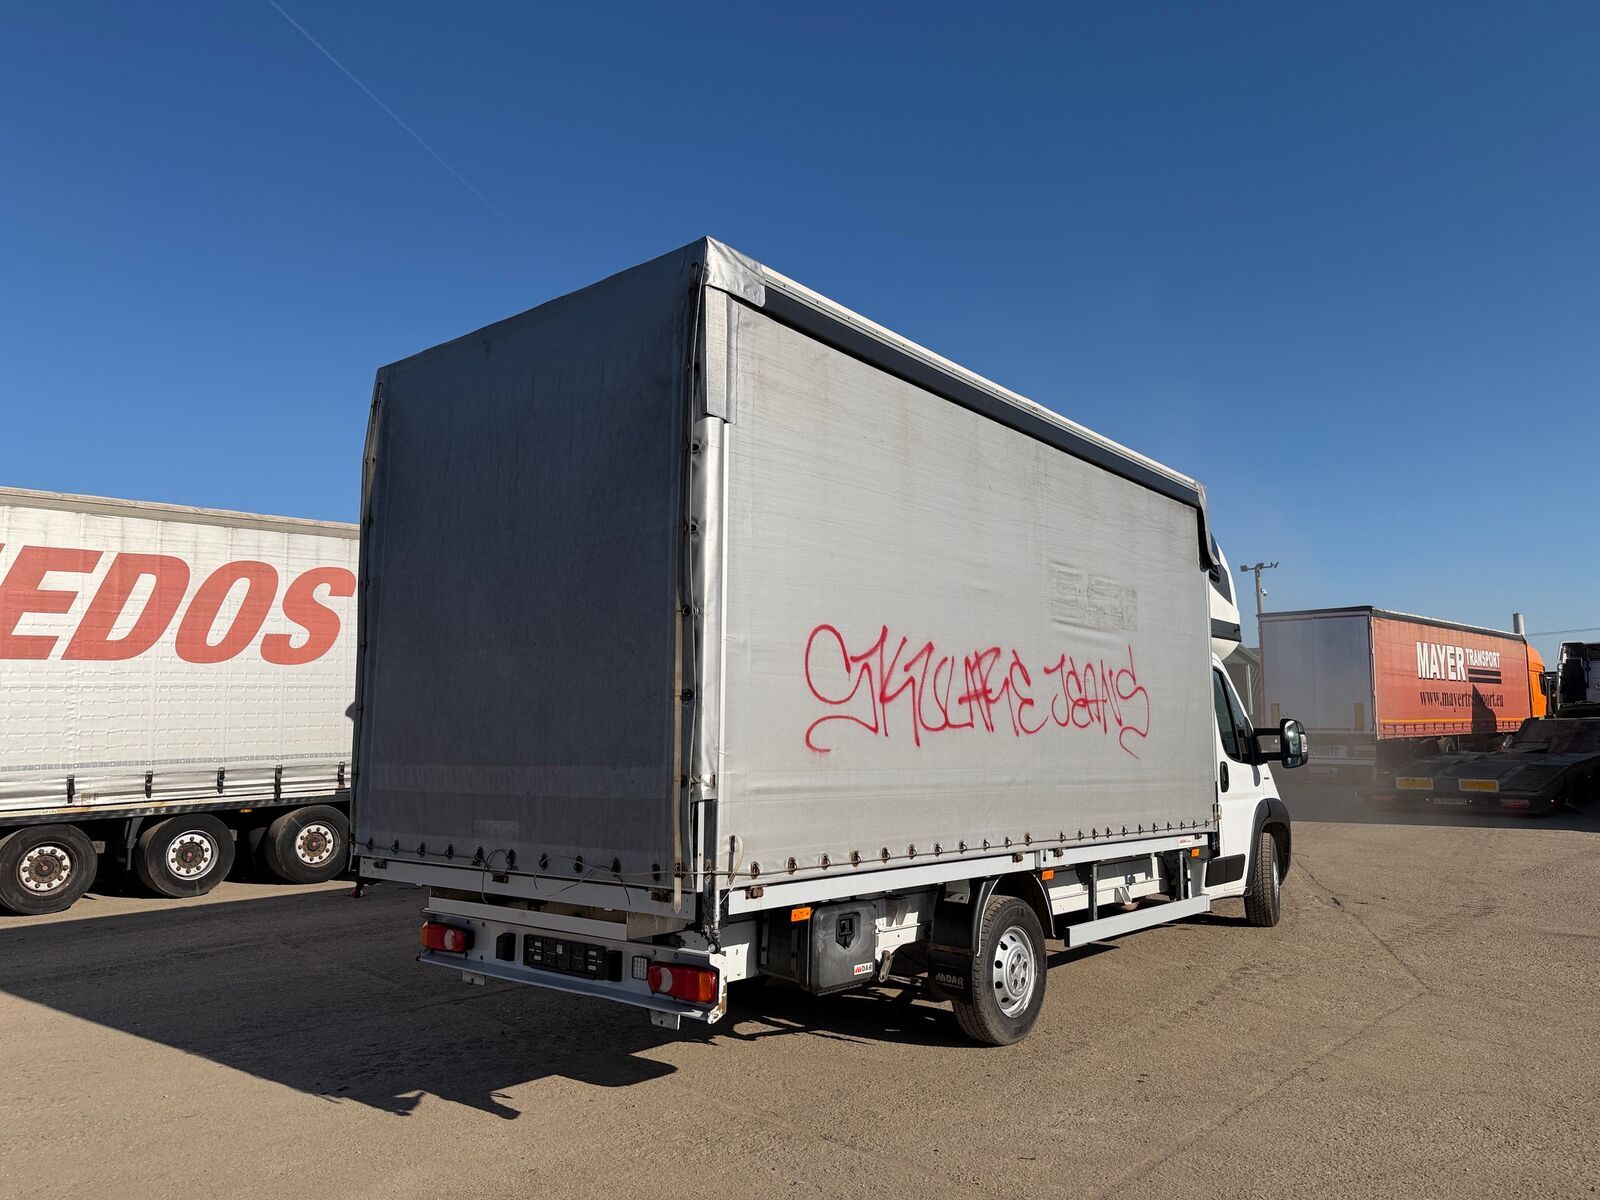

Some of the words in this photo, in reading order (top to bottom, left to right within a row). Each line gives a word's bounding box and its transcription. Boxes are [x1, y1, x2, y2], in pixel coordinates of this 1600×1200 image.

[0, 543, 356, 665] EDOS
[1416, 641, 1467, 682] MAYER
[1465, 648, 1500, 669] TRANSPORT
